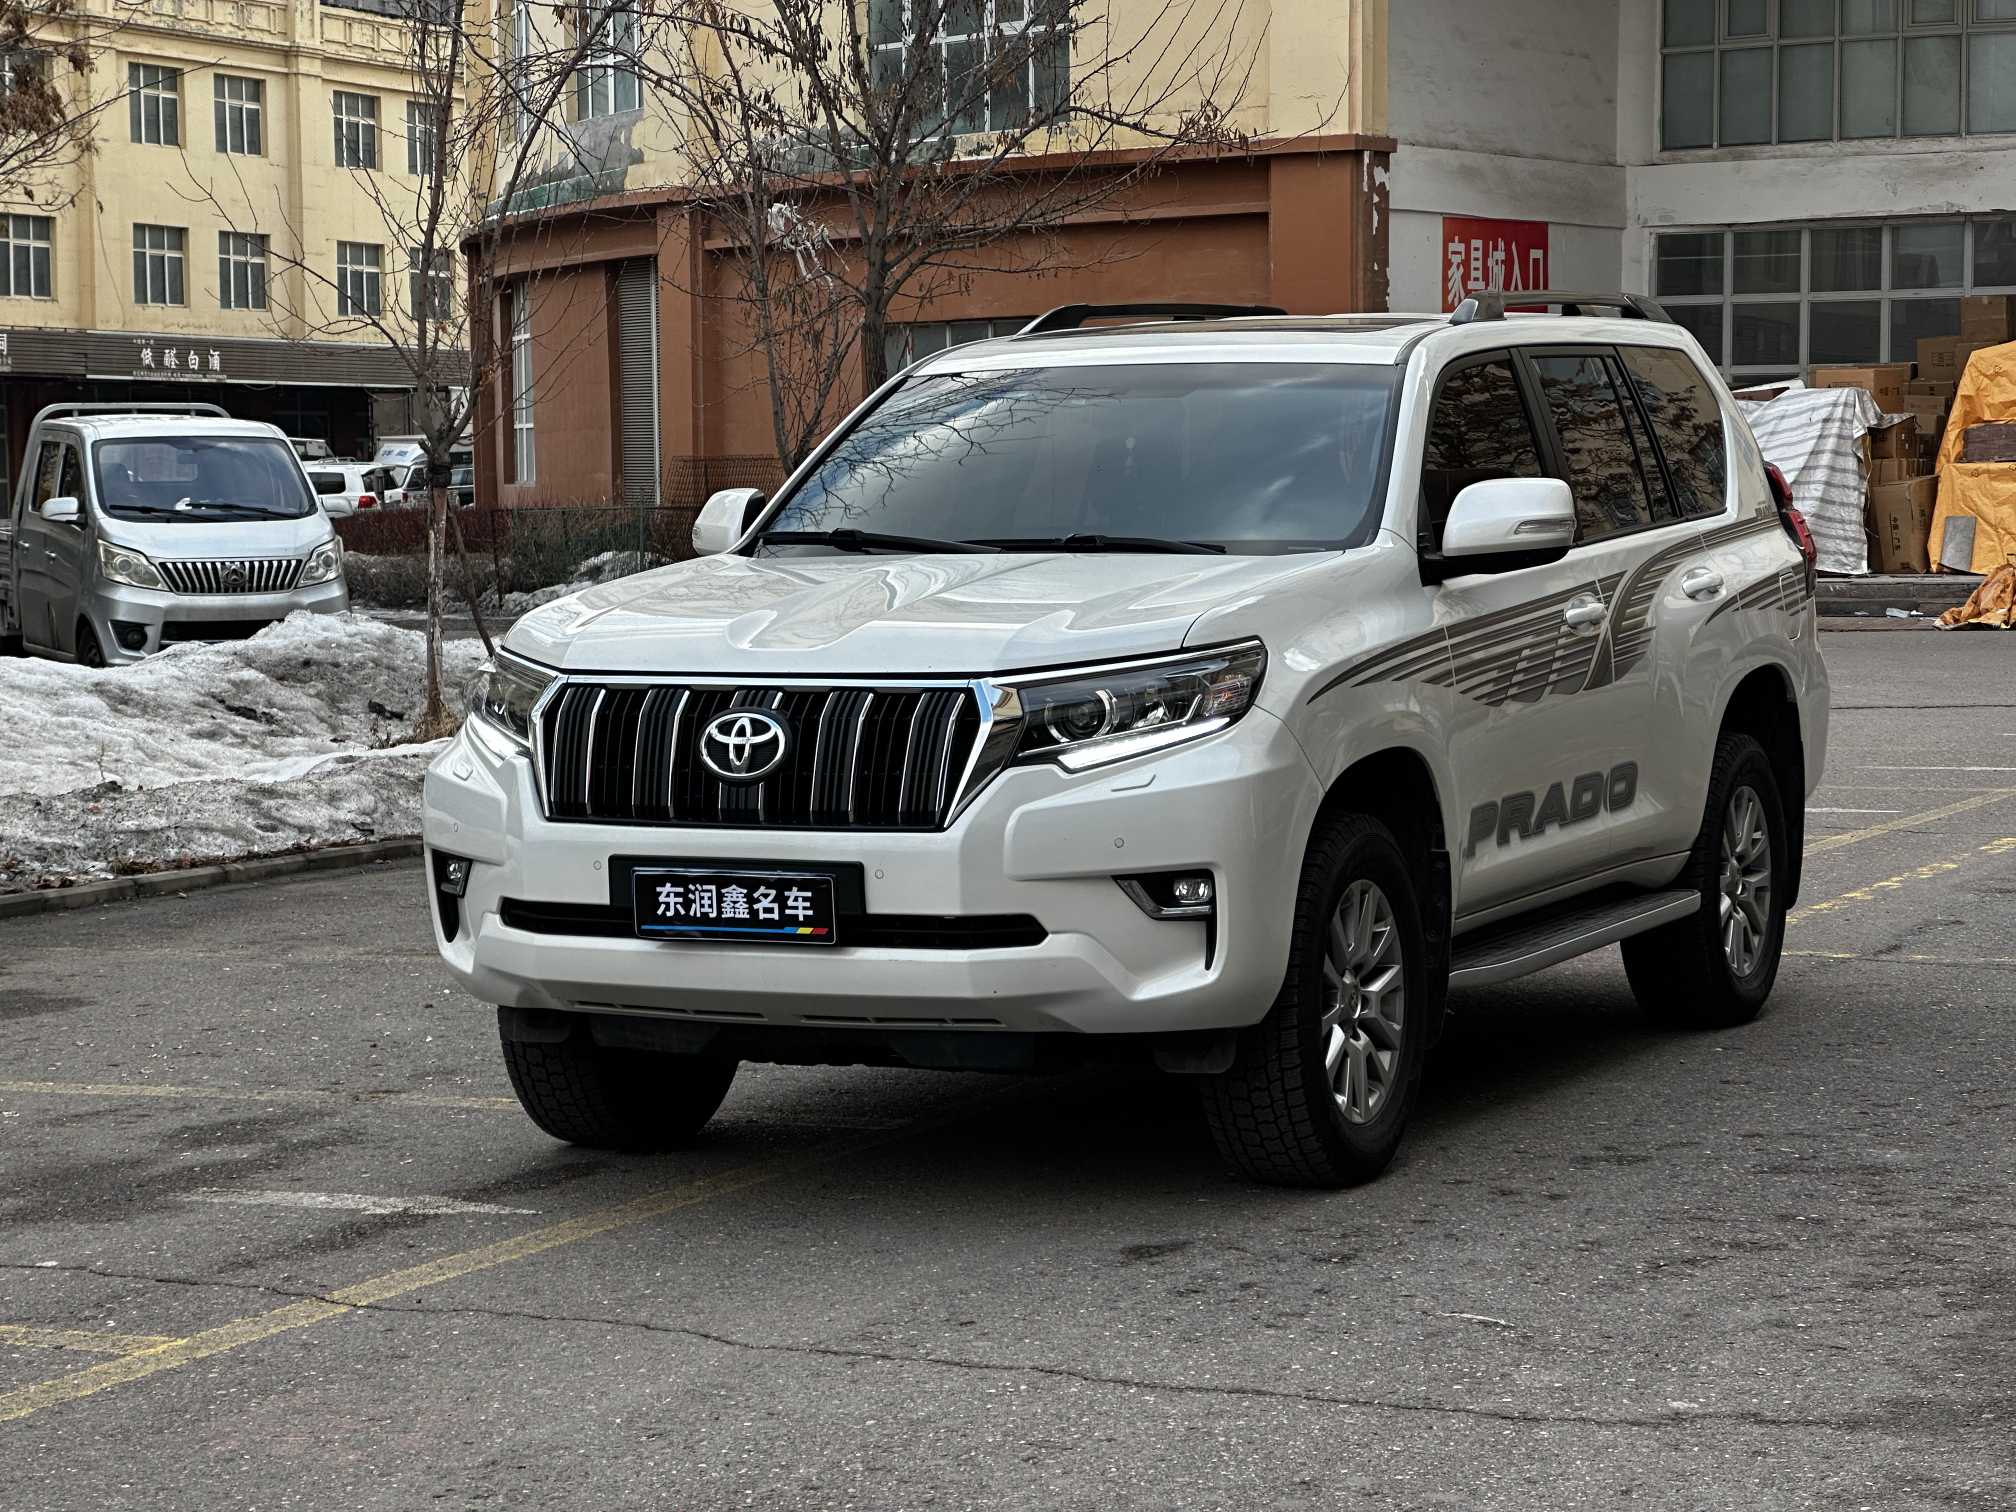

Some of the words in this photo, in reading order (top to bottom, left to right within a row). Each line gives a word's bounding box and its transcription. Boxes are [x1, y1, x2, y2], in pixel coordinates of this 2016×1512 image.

[1463, 760, 1638, 860] PRADO
[655, 882, 814, 922] 东润鑫名车
